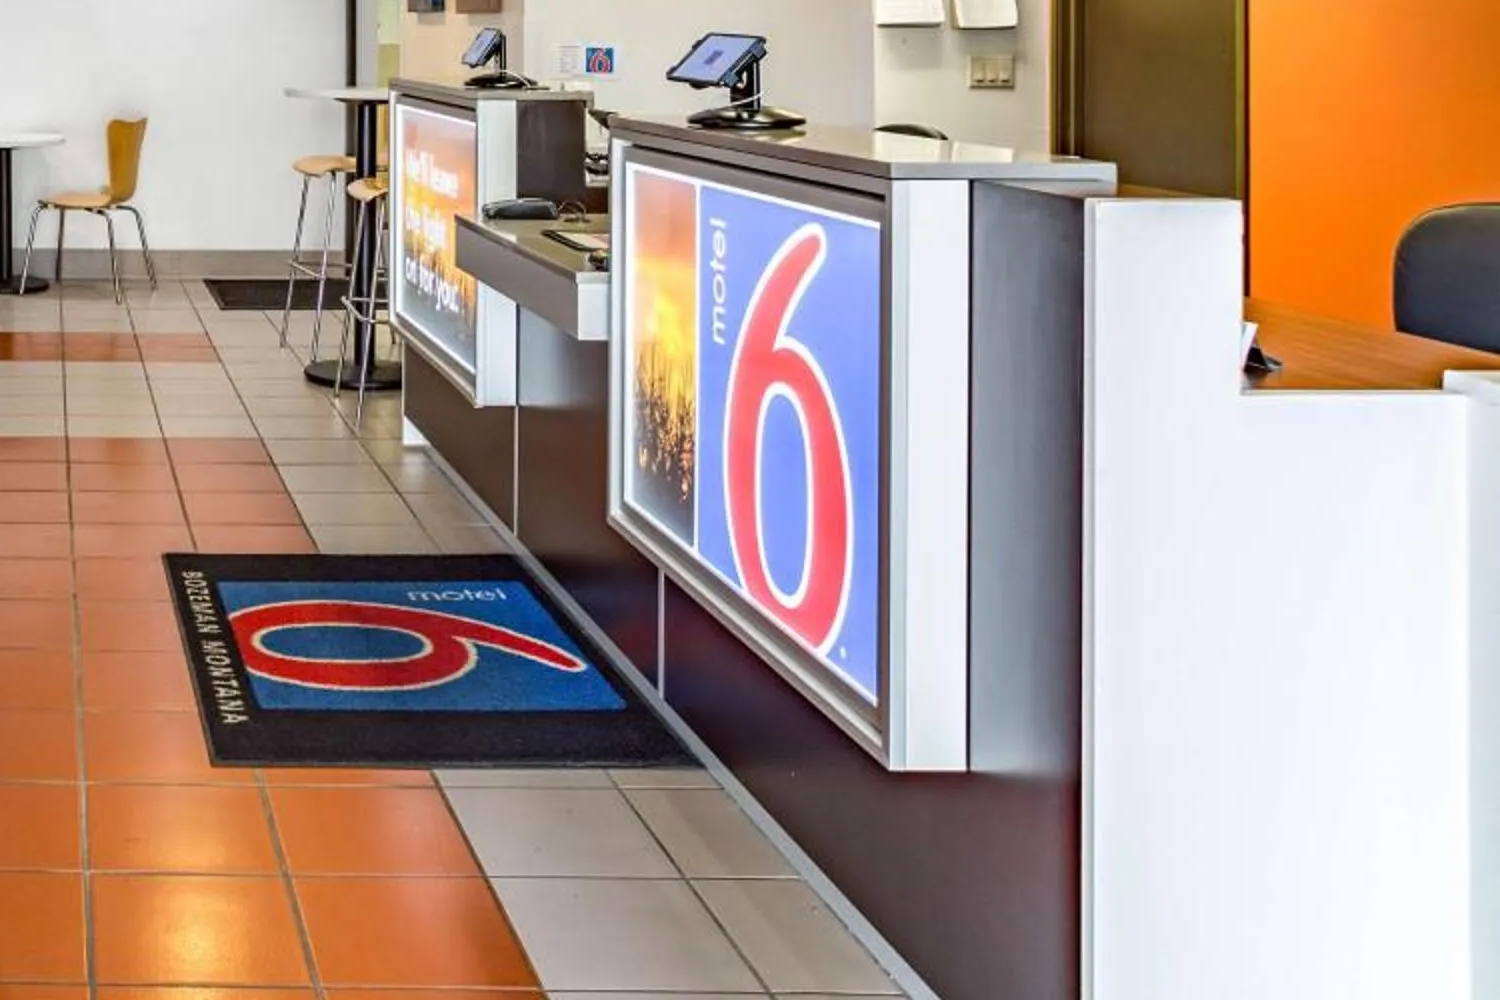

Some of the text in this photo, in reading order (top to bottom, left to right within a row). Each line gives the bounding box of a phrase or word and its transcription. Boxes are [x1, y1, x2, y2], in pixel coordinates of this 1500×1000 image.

[405, 256, 417, 285] on
[418, 252, 435, 296] for
[709, 217, 854, 660] motel 6
[181, 570, 250, 725] BOZEMAN MONTANA
[227, 587, 588, 692] motel 6
